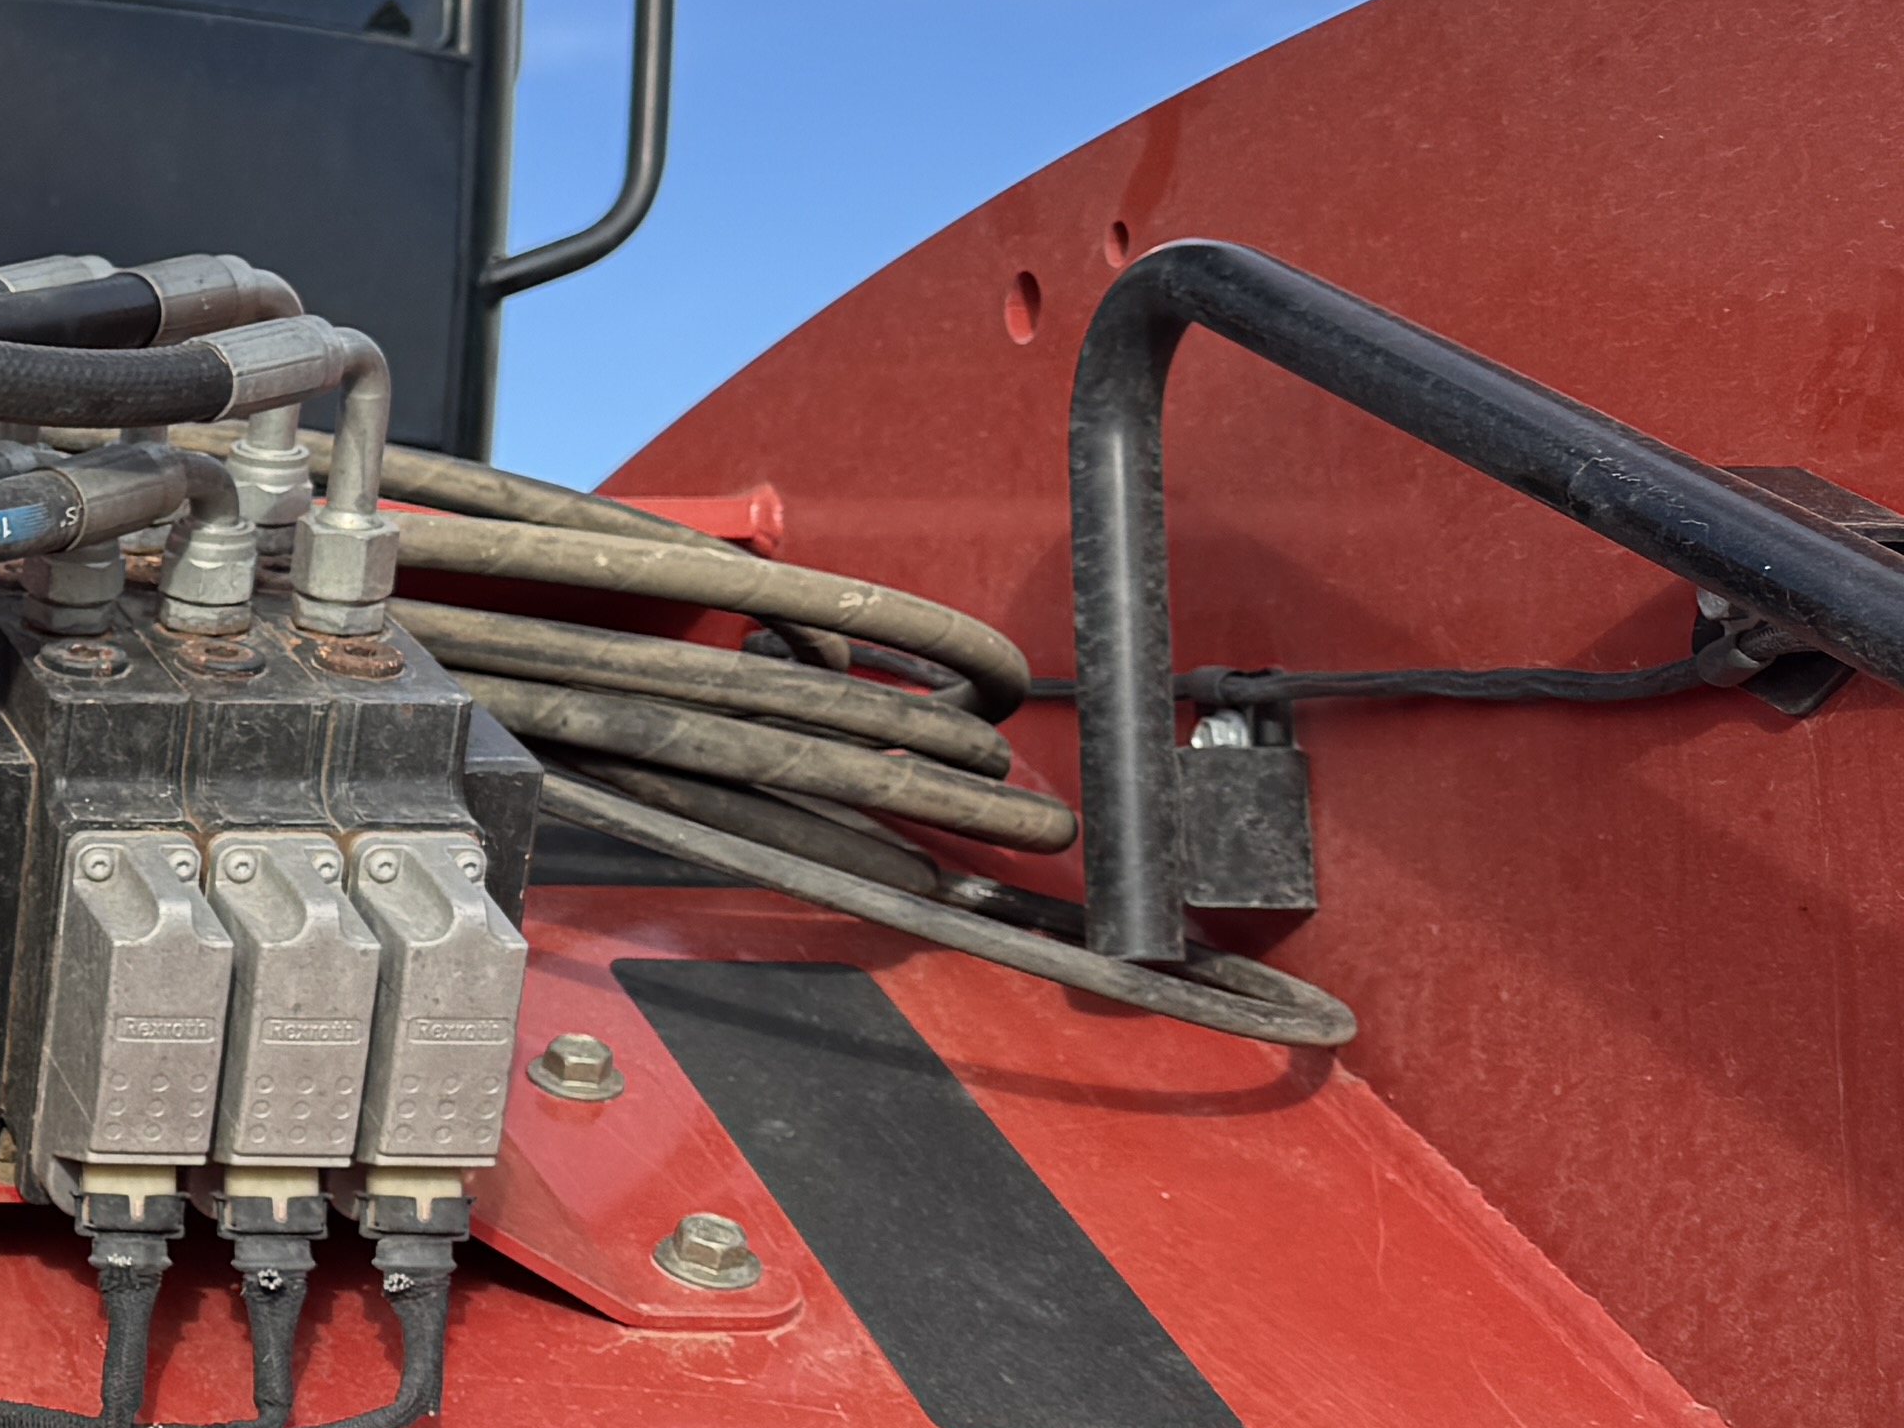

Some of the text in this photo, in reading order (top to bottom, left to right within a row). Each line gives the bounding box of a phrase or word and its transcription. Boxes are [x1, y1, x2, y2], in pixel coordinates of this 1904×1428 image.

[122, 1017, 208, 1038] Rexroth
[271, 1018, 355, 1040] Rexroth
[418, 1018, 502, 1040] Rexroth
